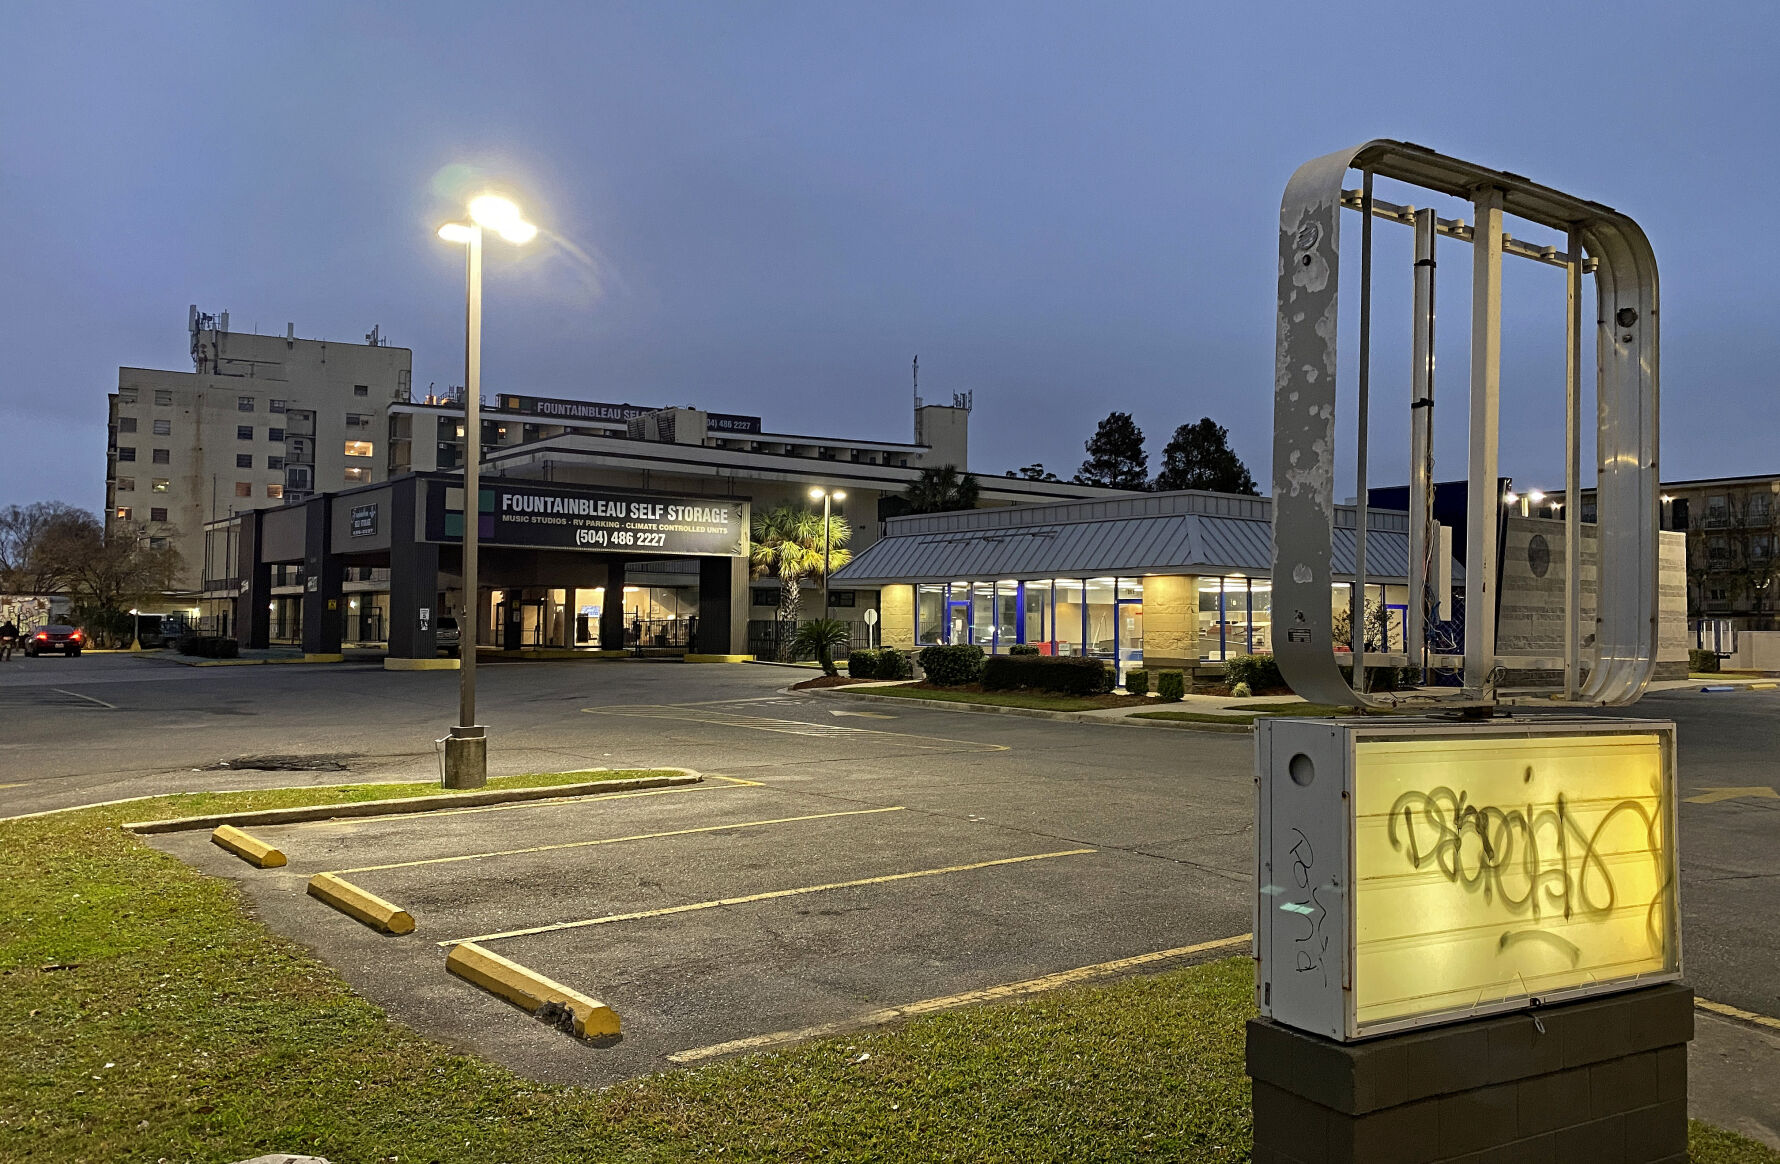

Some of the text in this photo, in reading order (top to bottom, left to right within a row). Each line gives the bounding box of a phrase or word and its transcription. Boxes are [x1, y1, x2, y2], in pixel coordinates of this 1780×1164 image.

[537, 402, 621, 420] FOUNTAINBLEAU
[623, 409, 647, 421] SEL
[706, 418, 717, 429] 04)
[733, 421, 751, 431] 2227
[502, 494, 729, 524] FOUNTAINBLEAU SELF STORAGE
[502, 515, 529, 523] MUSIC
[531, 516, 567, 525] STUDIOS
[586, 520, 620, 528] PARKING
[625, 522, 658, 530] CLIMATE
[659, 523, 706, 533] CONTROLLED
[706, 526, 728, 534] UNITS
[576, 529, 666, 547] (504) 486 2227
